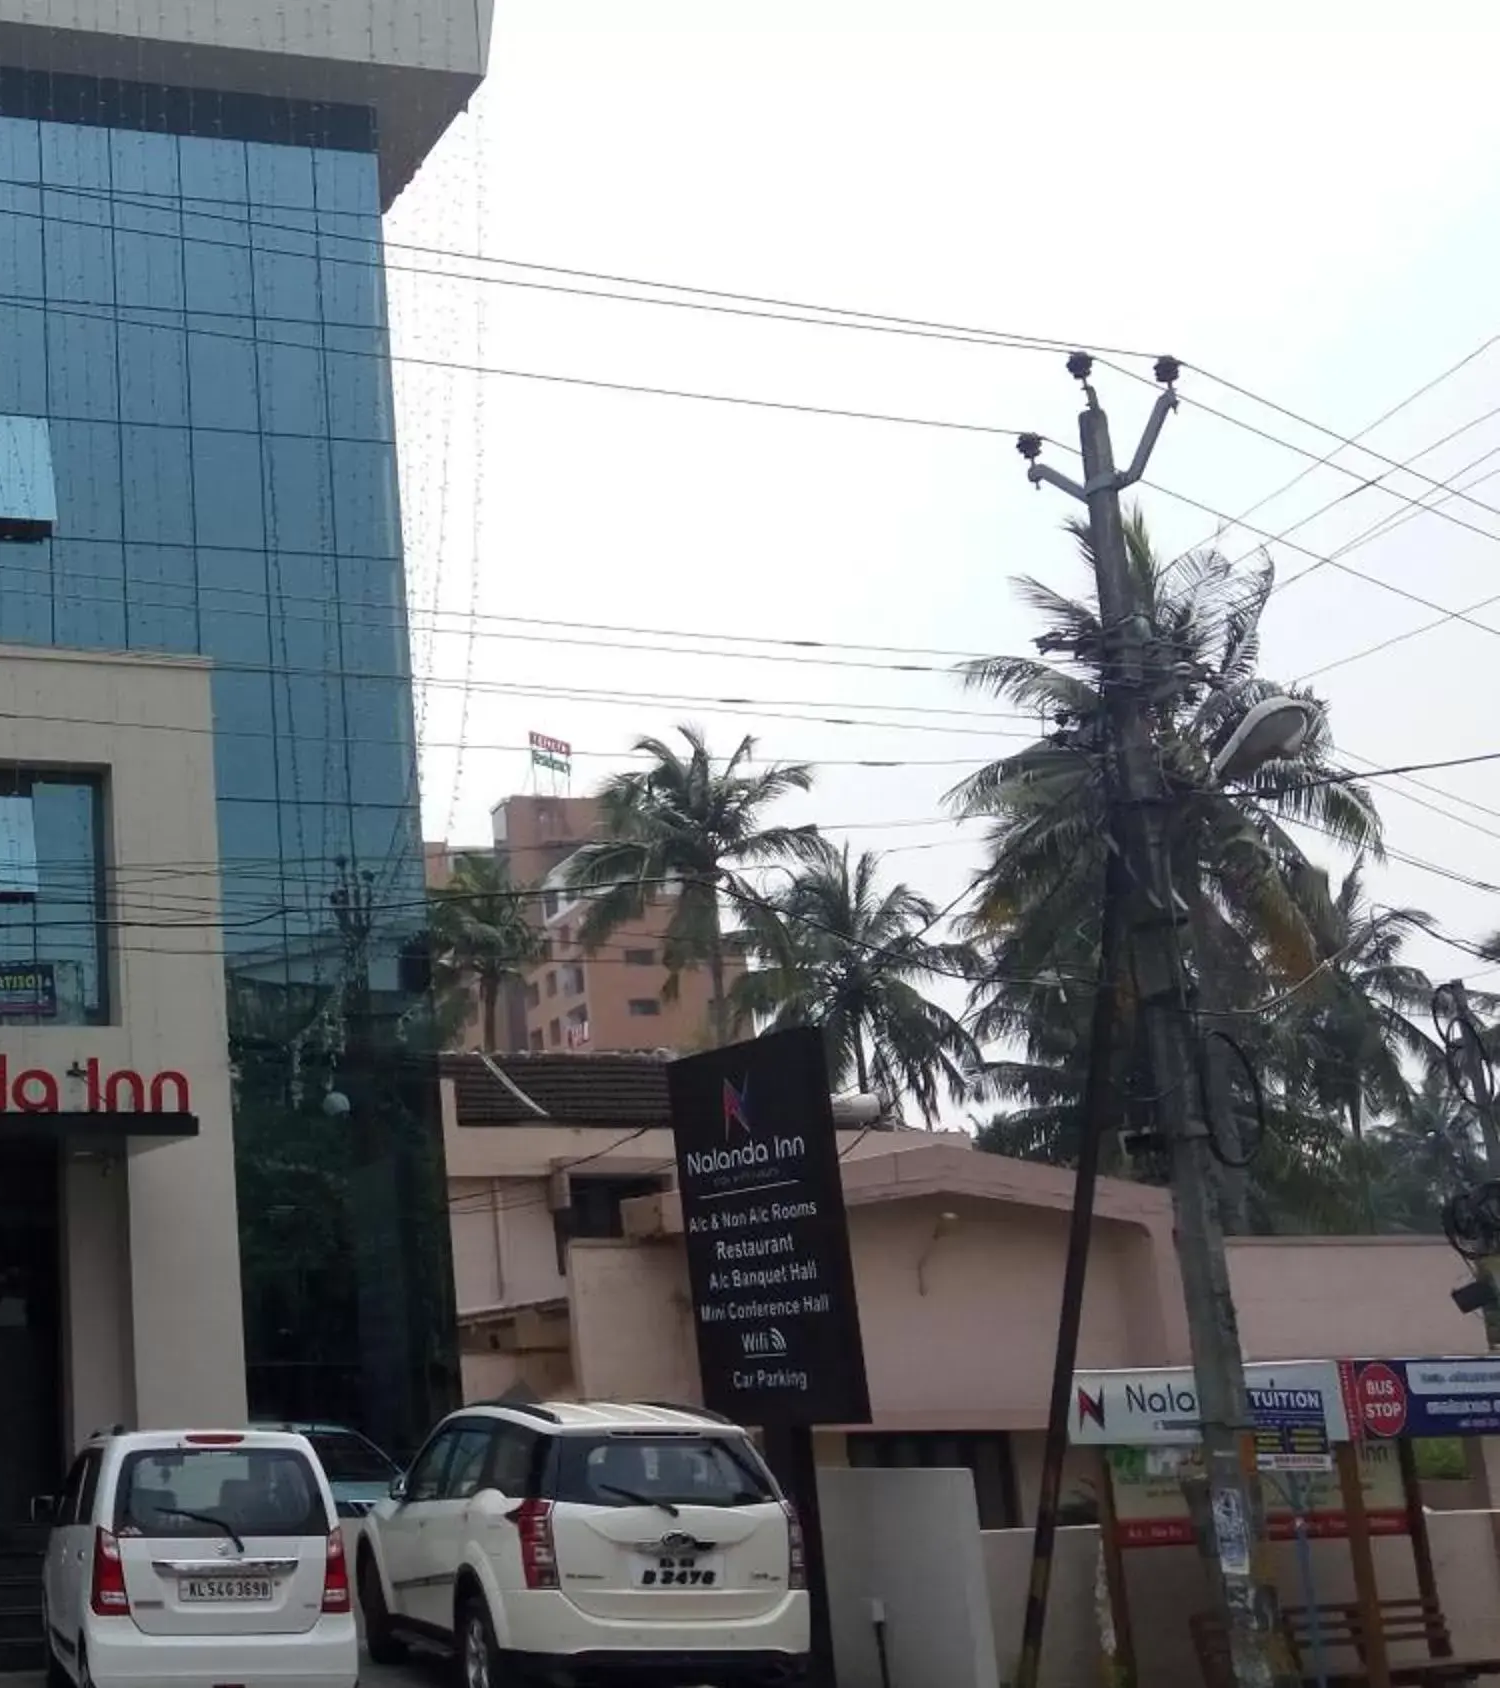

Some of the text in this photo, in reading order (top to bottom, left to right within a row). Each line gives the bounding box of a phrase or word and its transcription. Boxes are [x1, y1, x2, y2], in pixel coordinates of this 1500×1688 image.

[87, 1057, 190, 1113] Inn
[687, 1139, 769, 1177] Nalanda
[773, 1135, 805, 1160] Inn
[710, 1213, 719, 1231] &
[721, 1210, 747, 1229] Non
[771, 1201, 817, 1221] Rooms
[715, 1232, 795, 1260] Restaurant
[731, 1264, 788, 1288] Banquet
[789, 1259, 818, 1281] Hall
[701, 1293, 829, 1322] Mini Conference Hall
[741, 1332, 769, 1352] Wifi
[733, 1368, 807, 1391] Car Parking
[1365, 1379, 1394, 1396] BUS
[1125, 1383, 1196, 1413] Nala
[1250, 1391, 1320, 1409] TUITION
[1365, 1402, 1403, 1419] STOP
